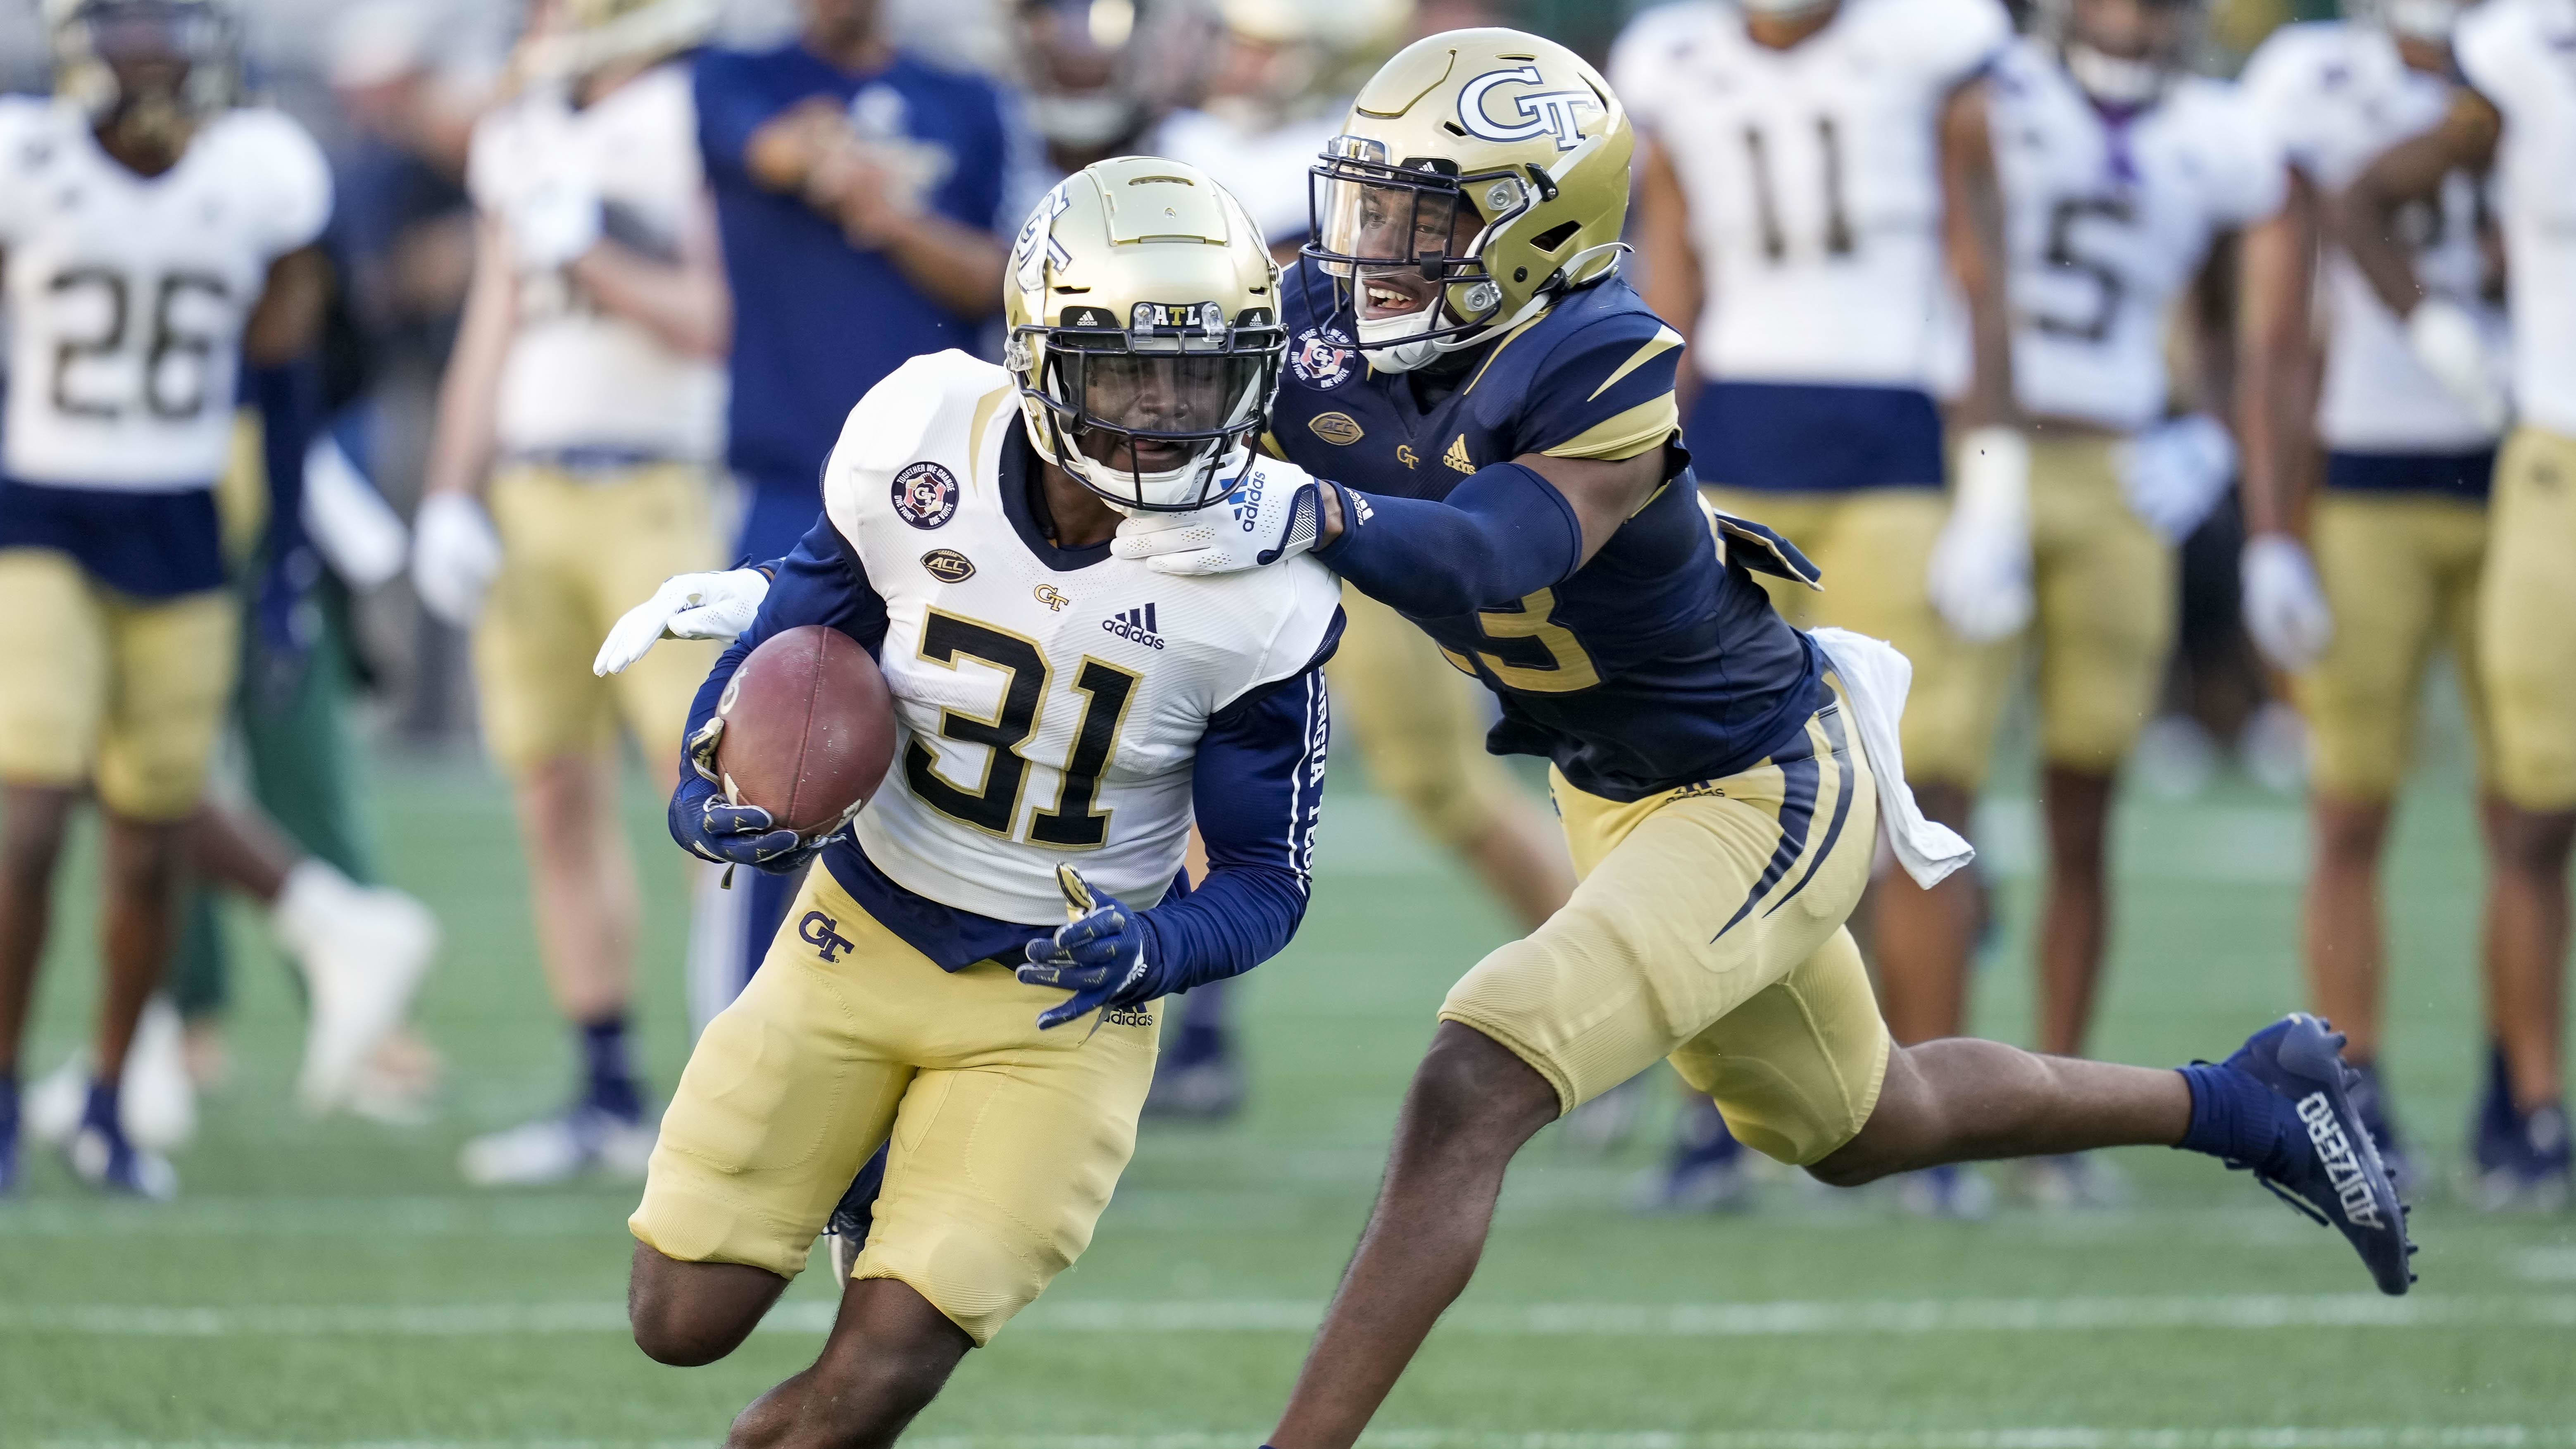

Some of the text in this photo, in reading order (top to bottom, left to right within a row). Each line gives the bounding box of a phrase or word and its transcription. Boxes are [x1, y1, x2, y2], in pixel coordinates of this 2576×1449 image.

[1457, 66, 1598, 152] GT
[1337, 137, 1371, 162] ATL
[1742, 116, 1867, 261] 11
[2028, 194, 2134, 341] 5
[1152, 305, 1200, 326] ATL
[48, 266, 228, 419] 26
[1291, 351, 1300, 364] ONE
[1312, 348, 1334, 366] GT
[1396, 444, 1419, 470] GT
[1443, 455, 1476, 475] adidas
[896, 464, 955, 492] TOGETHER WE CHANGE
[894, 495, 916, 522] ONE FIGHT
[914, 487, 936, 504] GT
[1242, 471, 1266, 532] adidas
[1344, 487, 1364, 526] adidas
[929, 502, 954, 526] ONE VOICE
[929, 557, 967, 573] ACC
[1034, 584, 1069, 612] GT
[1102, 619, 1165, 650] adidas
[902, 603, 1144, 852] 31
[1303, 794, 1323, 875] TEC
[799, 911, 855, 962] GT
[1103, 1008, 1153, 1027] didas
[2296, 1091, 2385, 1230] ADIZERO
